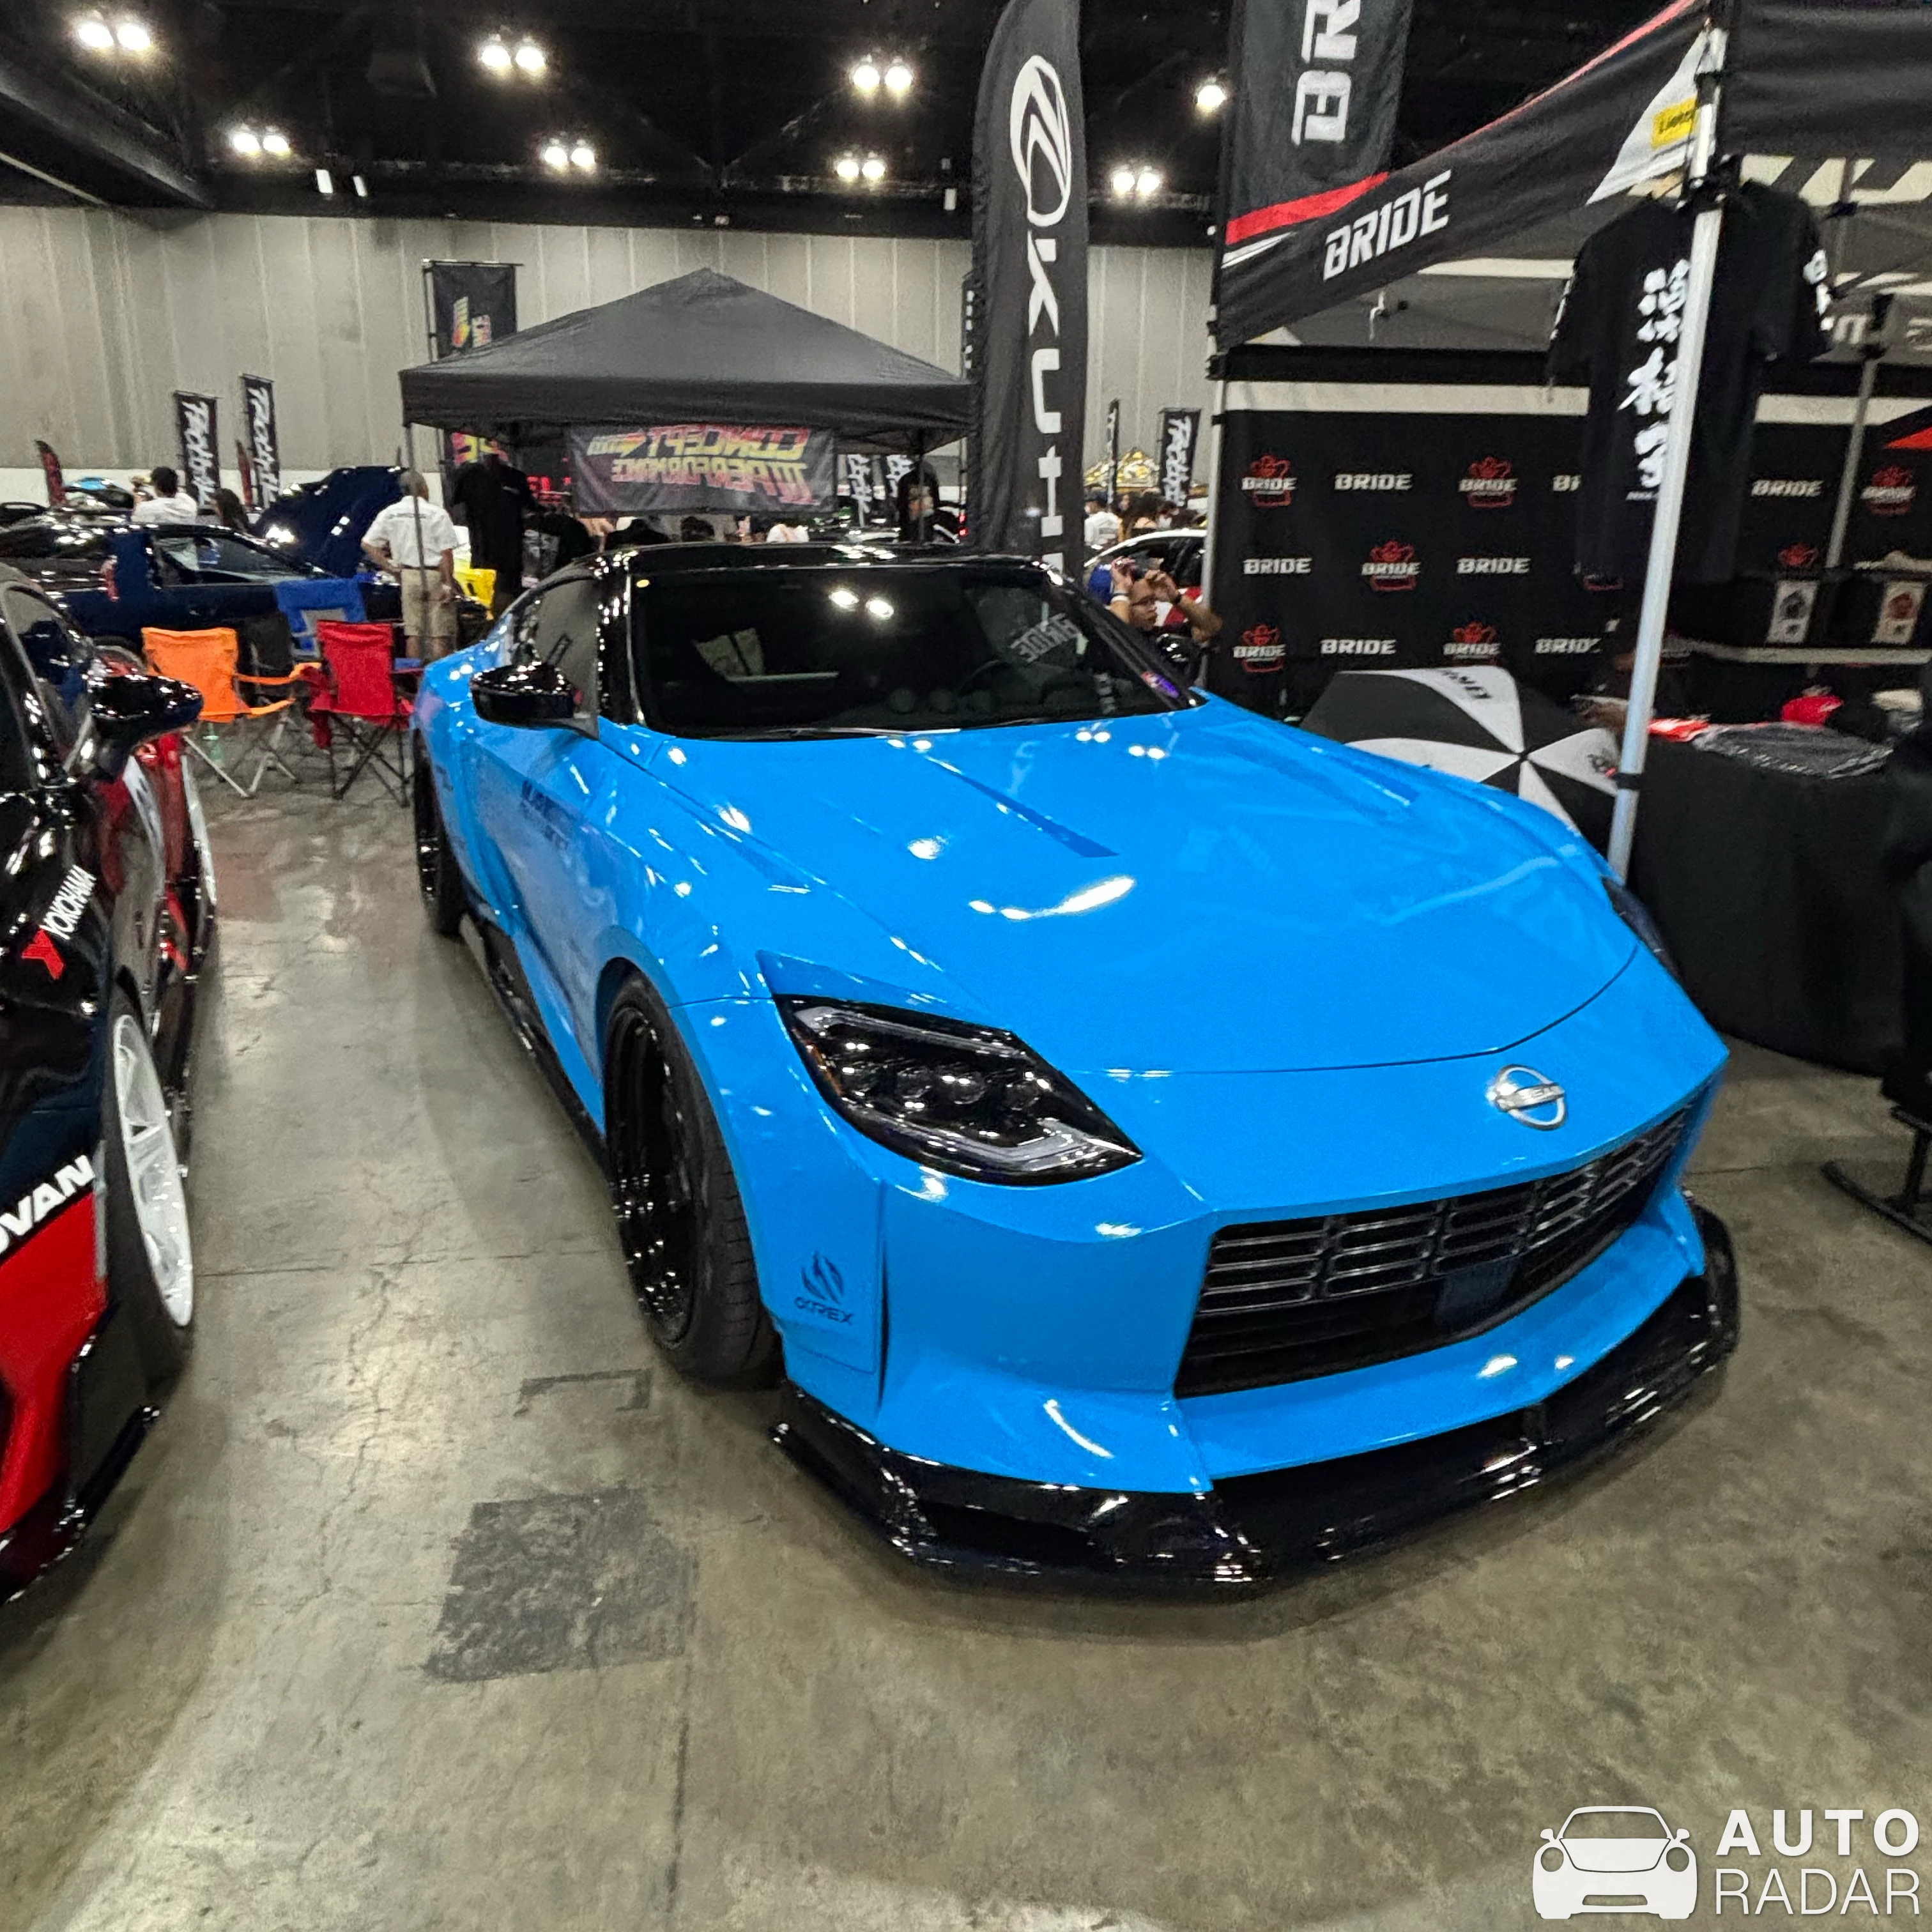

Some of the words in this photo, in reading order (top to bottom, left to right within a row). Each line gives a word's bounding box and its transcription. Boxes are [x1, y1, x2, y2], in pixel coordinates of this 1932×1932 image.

[1323, 169, 1452, 281] BRIDE
[1027, 229, 1063, 575] KUH
[1241, 477, 1297, 491] BRIDE
[1334, 473, 1413, 491] BRIDE
[1458, 479, 1518, 492] BRIDE
[1751, 480, 1825, 498] BRIDE
[1243, 558, 1312, 575] BRIDE
[1361, 562, 1422, 576] BRIDE
[1456, 558, 1531, 574] BRIDE
[1232, 644, 1286, 659] BRIDE
[1320, 639, 1397, 655] BRIDE
[1443, 643, 1501, 656] BRIDE
[38, 864, 97, 940] YOKOHAMA
